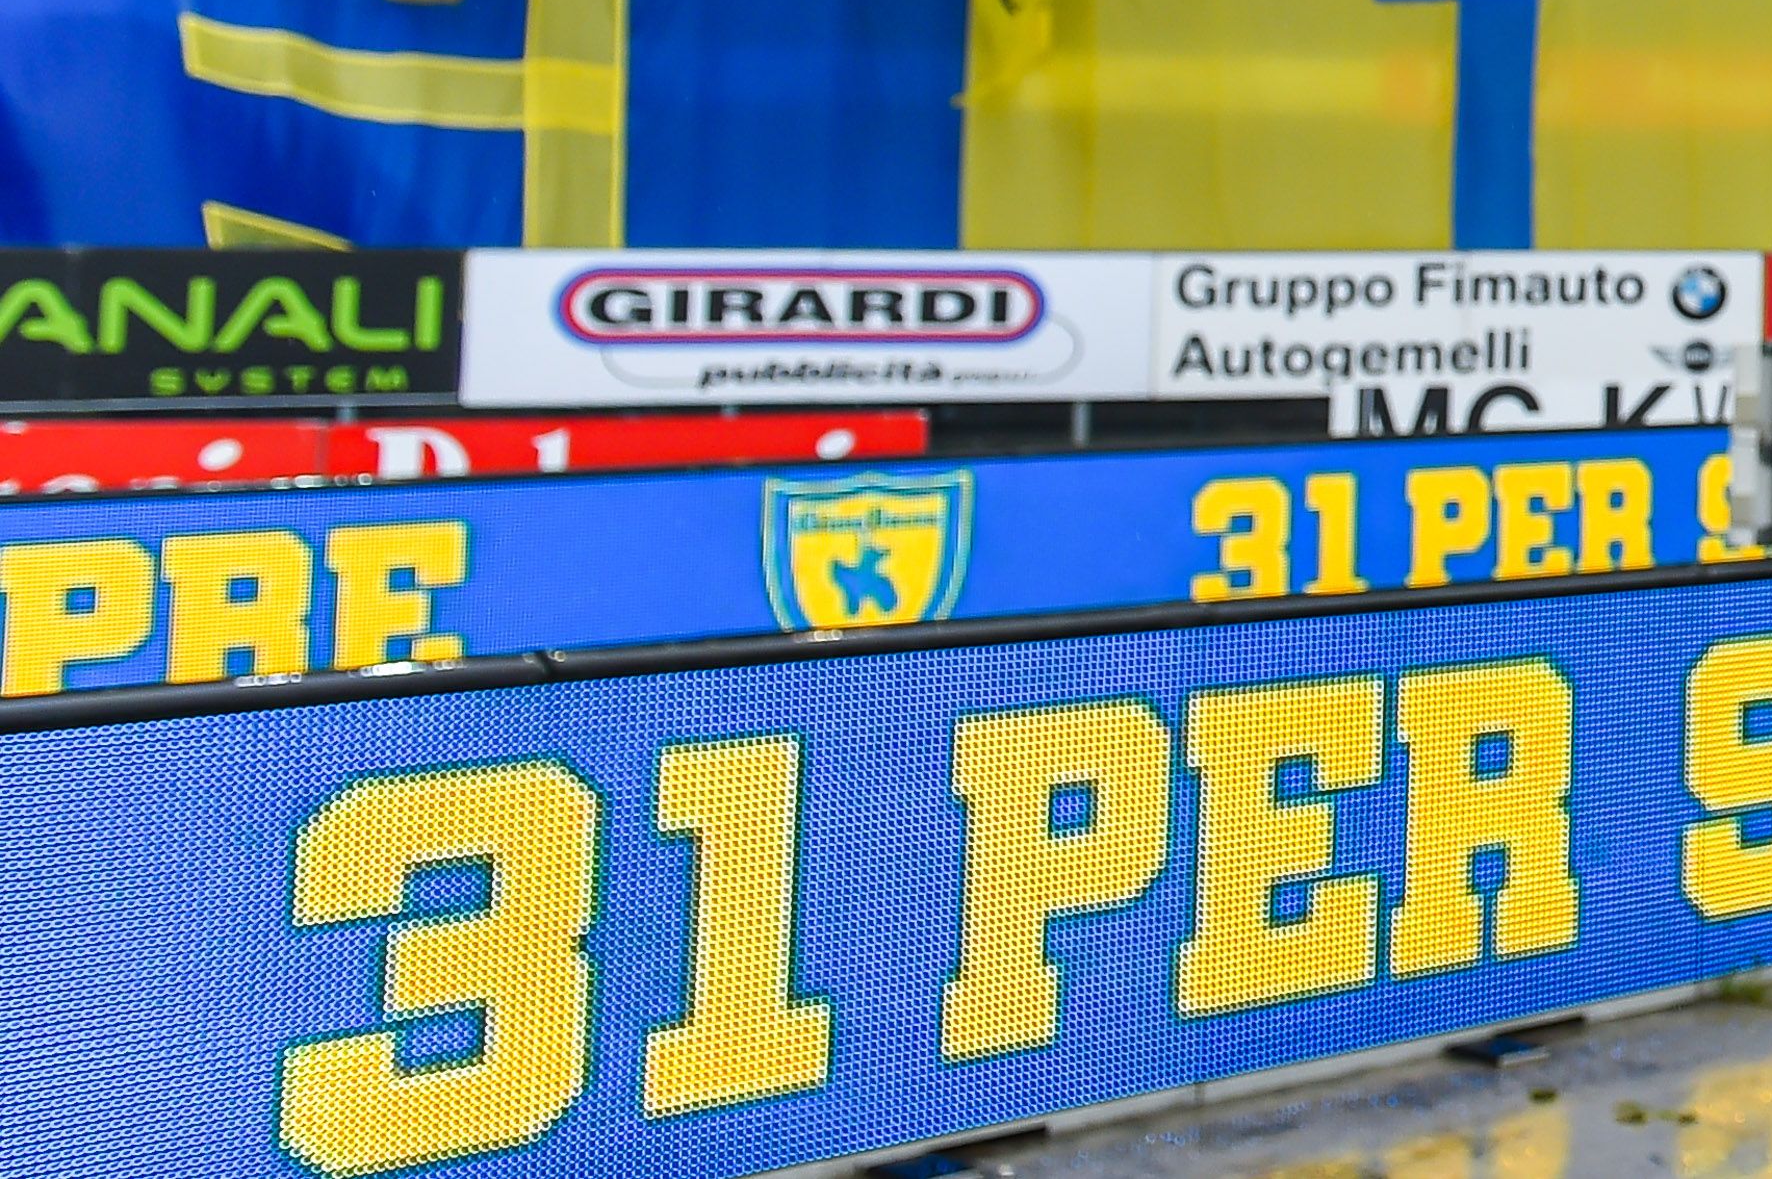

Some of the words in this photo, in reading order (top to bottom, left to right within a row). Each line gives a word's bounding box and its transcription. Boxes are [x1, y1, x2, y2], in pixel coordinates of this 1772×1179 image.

[0, 275, 444, 355] ANALI
[589, 288, 1009, 324] GIRARDI
[1175, 264, 1395, 316] Gruppo
[1415, 262, 1647, 307] Fimauto
[149, 365, 409, 395] SYSTEM
[1171, 328, 1532, 380] Autogemelli
[1191, 472, 1370, 604] 31
[1404, 456, 1655, 588] PER
[277, 733, 832, 1179] 31
[940, 656, 1580, 1066] PER
